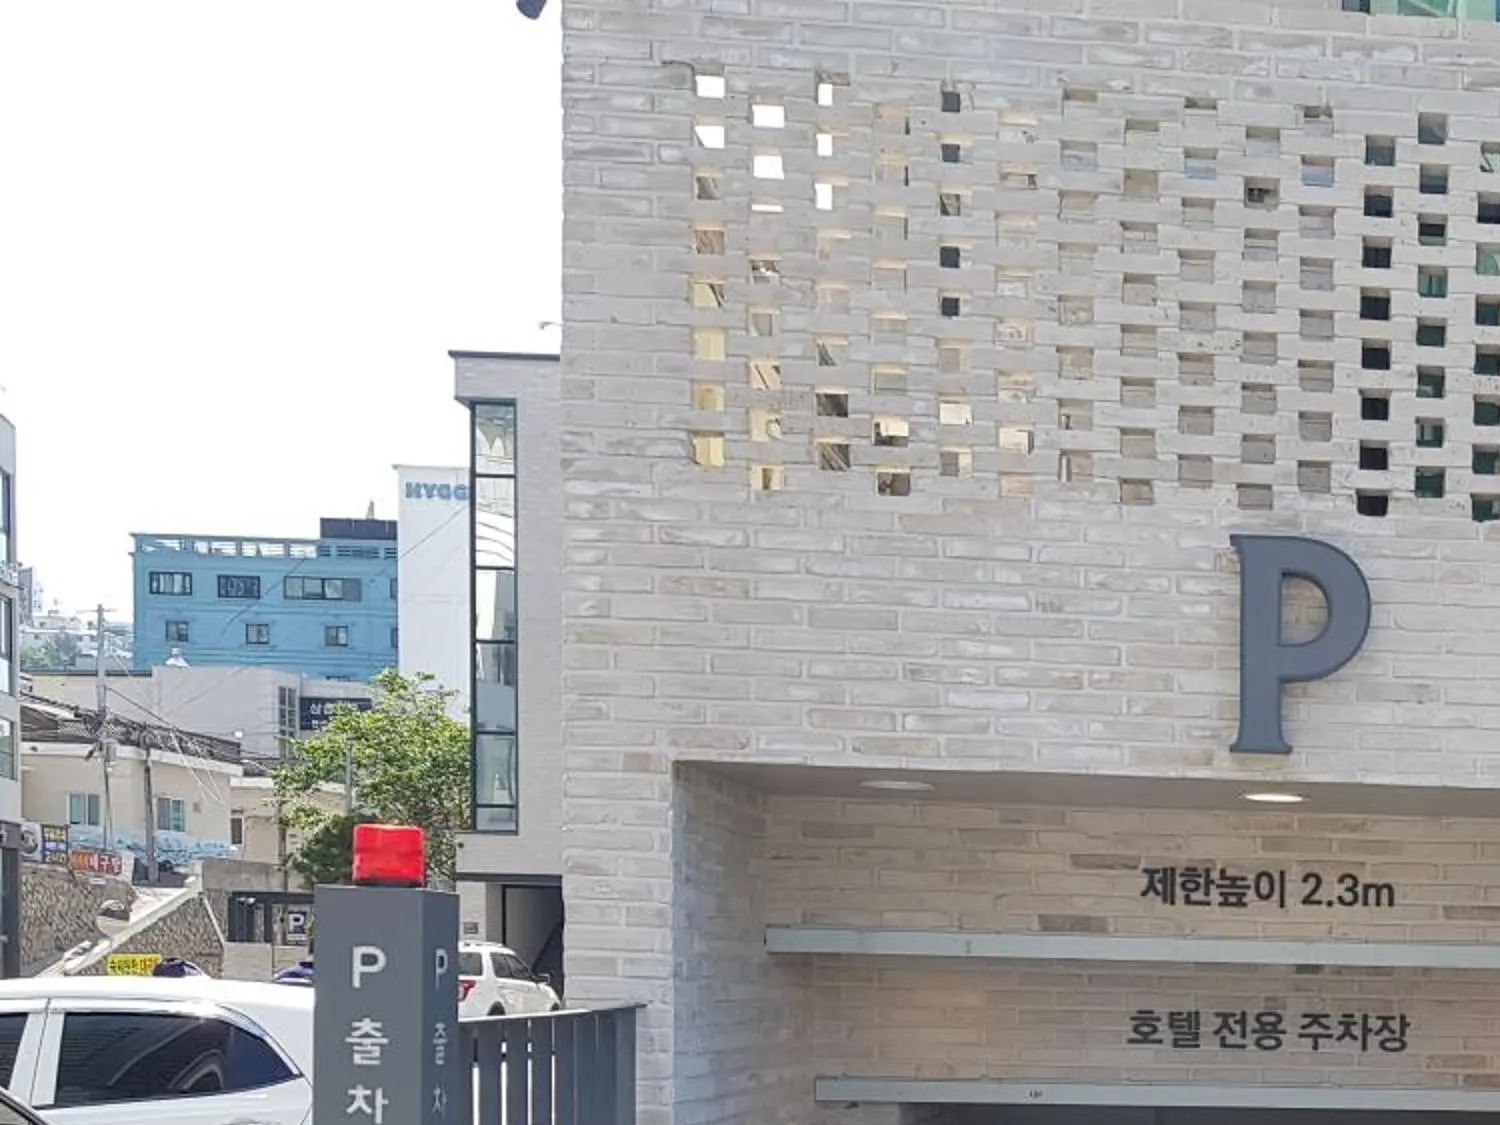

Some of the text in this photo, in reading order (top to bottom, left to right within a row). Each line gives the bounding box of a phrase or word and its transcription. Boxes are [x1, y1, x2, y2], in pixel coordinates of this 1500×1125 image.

[1230, 534, 1371, 754] P
[1140, 866, 1395, 908] 제한높이 2.3m
[289, 913, 305, 932] P
[352, 945, 387, 988] P
[435, 949, 449, 990] P
[1127, 1009, 1411, 1053] 호텔 전용 주차장
